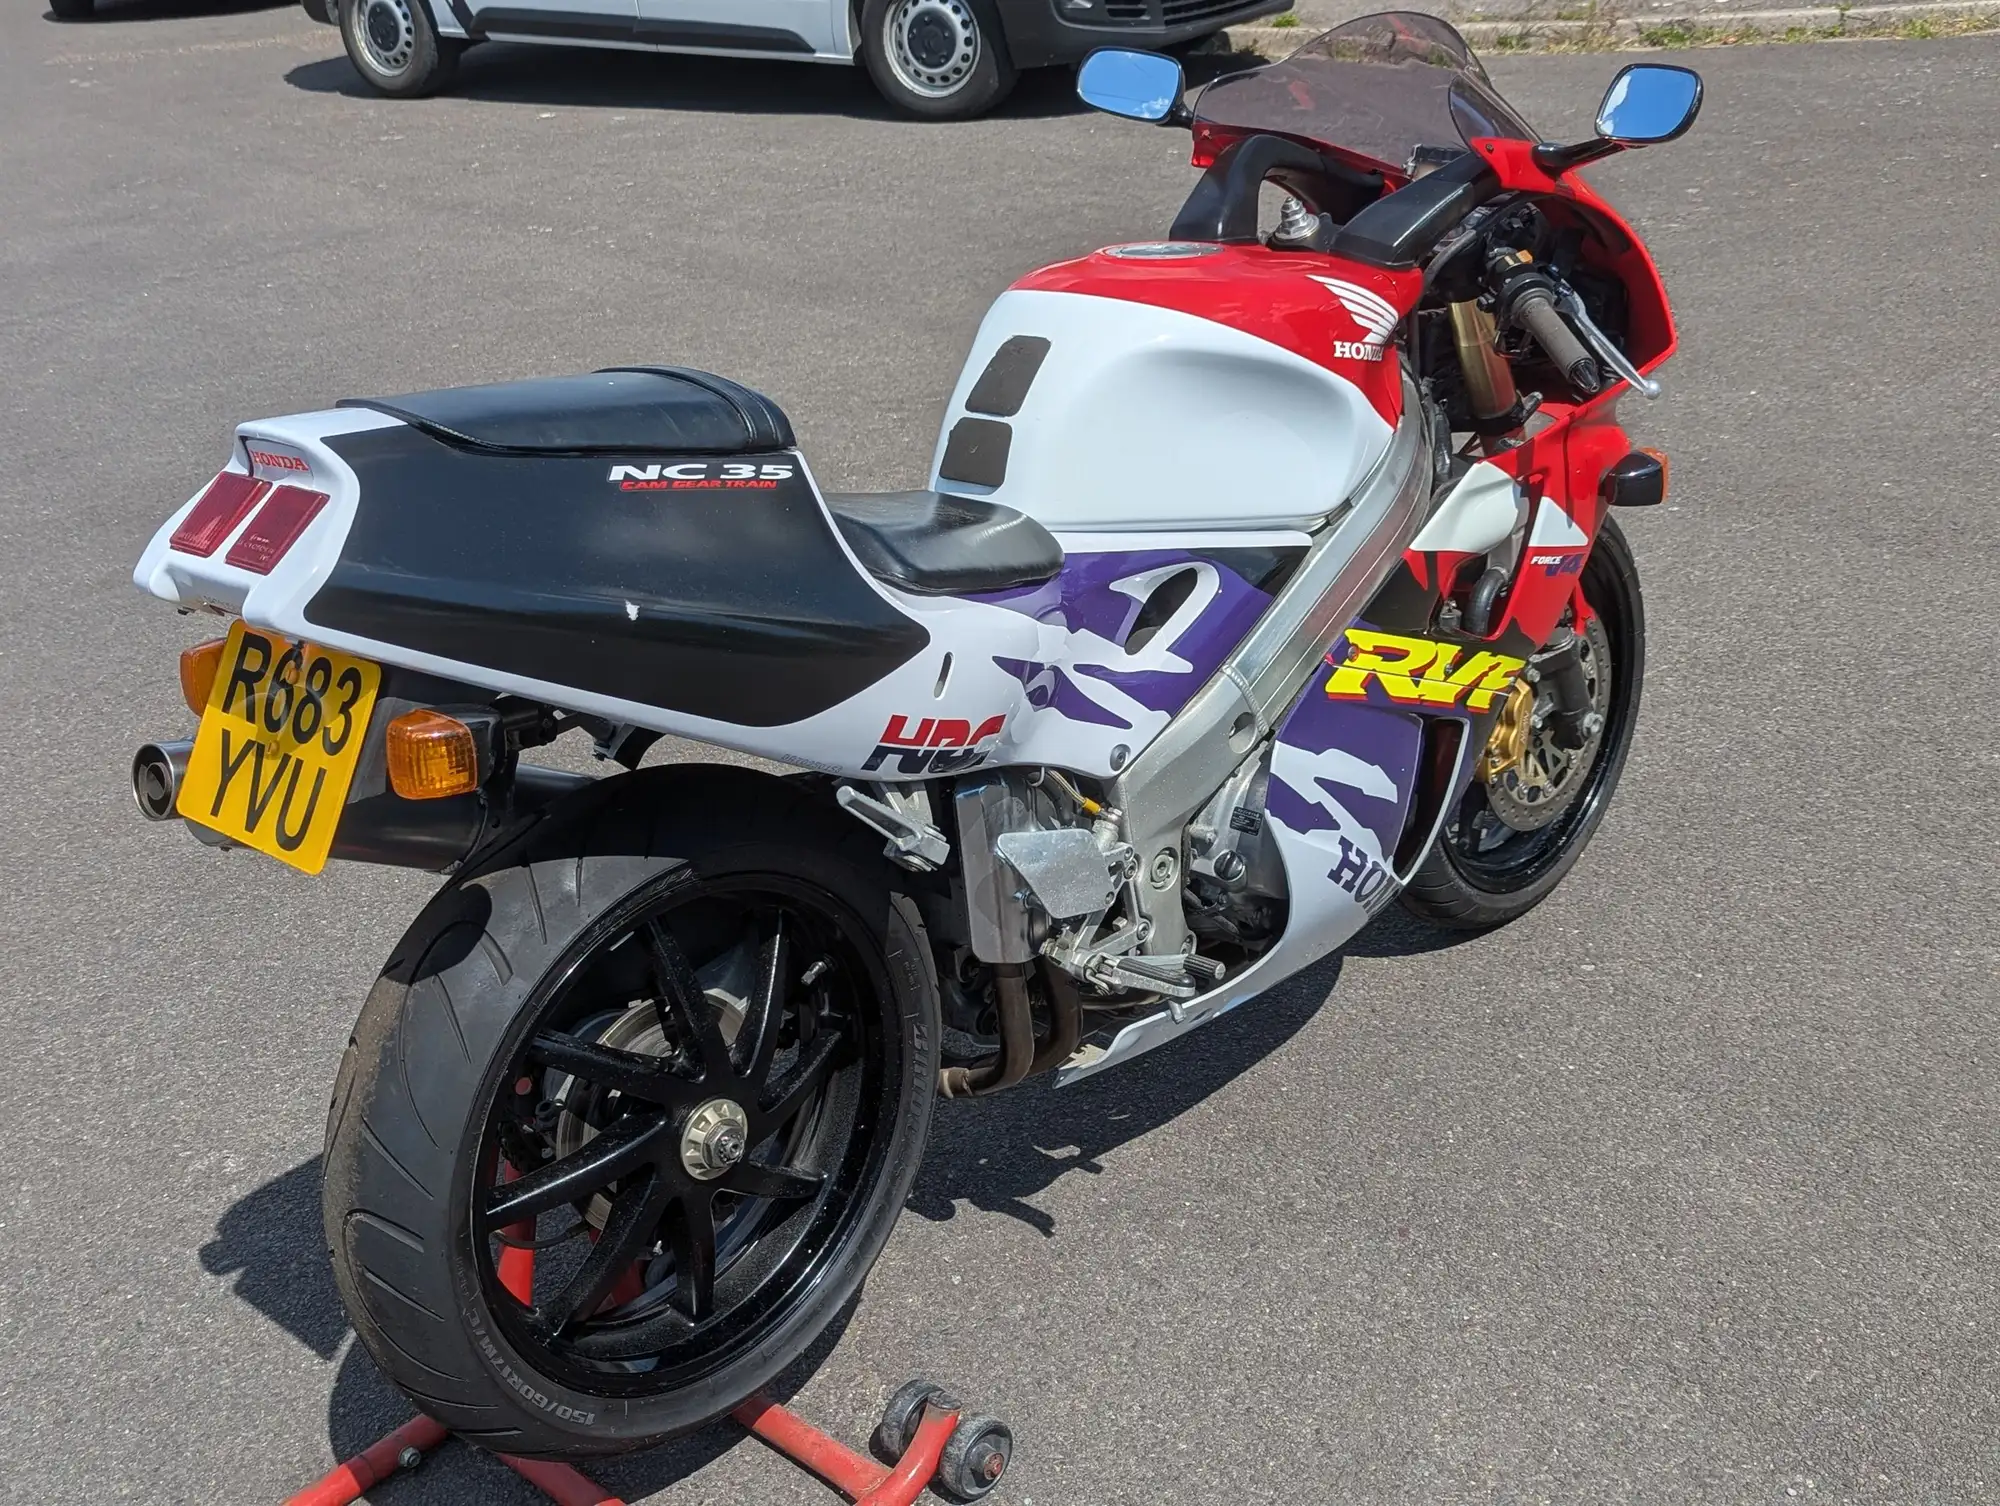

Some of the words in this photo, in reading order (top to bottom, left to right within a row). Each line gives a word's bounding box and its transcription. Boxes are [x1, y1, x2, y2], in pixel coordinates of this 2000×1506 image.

[1333, 341, 1384, 361] HONDA
[248, 449, 309, 471] HONDA
[609, 464, 707, 481] NC
[720, 464, 793, 480] 35
[622, 481, 668, 489] CAM
[672, 480, 721, 489] GEAR
[725, 480, 777, 489] TRAIN
[1530, 556, 1563, 565] FORCE
[1544, 553, 1585, 577] V4
[1325, 628, 1526, 714] RVF
[222, 631, 362, 756] R683
[860, 714, 1006, 774] HRC
[210, 728, 328, 851] YVU
